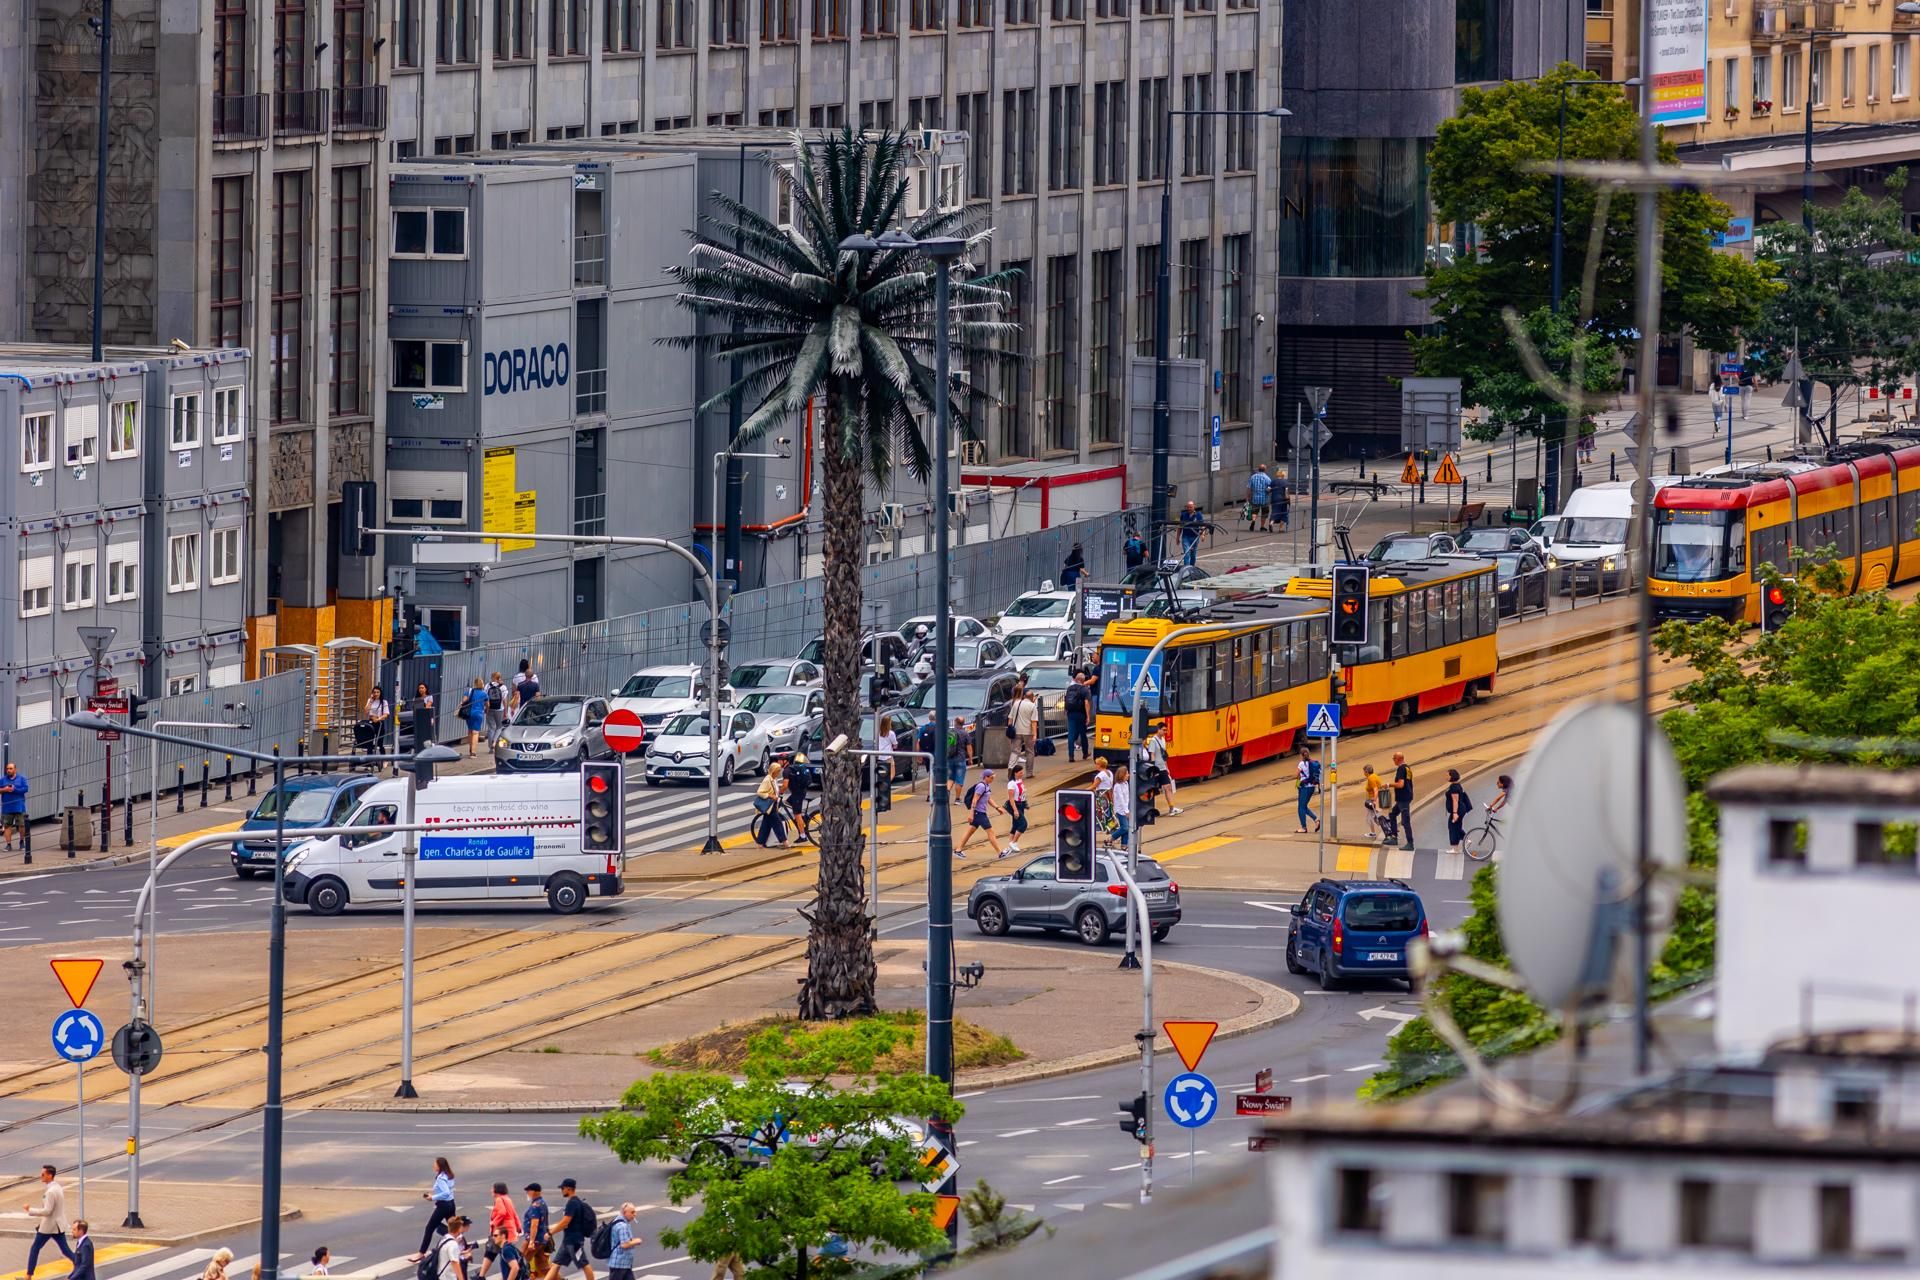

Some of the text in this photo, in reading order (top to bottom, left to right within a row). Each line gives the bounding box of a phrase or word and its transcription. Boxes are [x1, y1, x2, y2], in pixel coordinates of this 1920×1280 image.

[484, 342, 569, 396] DORACO
[108, 700, 123, 709] Świat
[517, 802, 529, 811] do
[530, 803, 549, 811] wina
[468, 838, 488, 846] Rondo
[424, 846, 530, 859] gen. Charles'a de Gaulle'a
[1242, 1099, 1284, 1111] Nowy Świat
